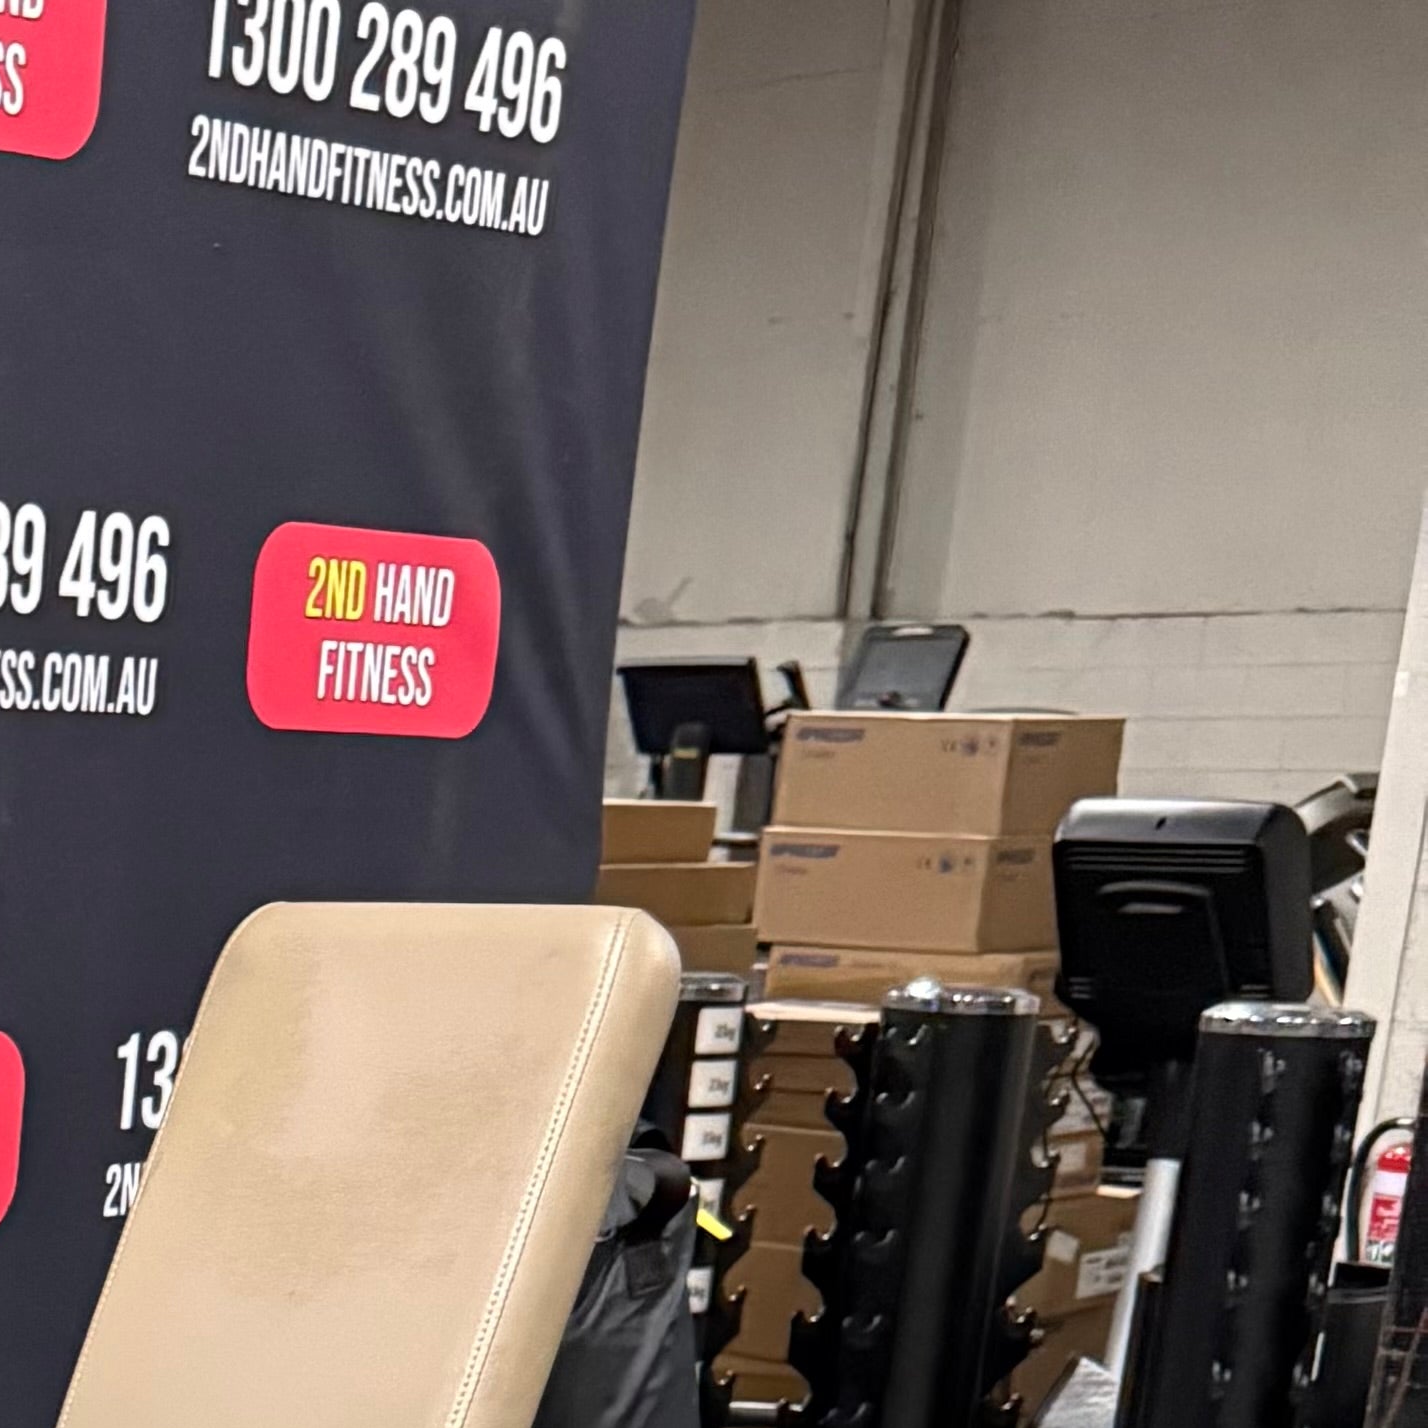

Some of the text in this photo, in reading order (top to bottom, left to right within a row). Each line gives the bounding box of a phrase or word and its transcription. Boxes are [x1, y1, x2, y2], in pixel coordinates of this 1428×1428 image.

[349, 2, 457, 125] 289
[464, 26, 567, 144] 496
[188, 114, 549, 237] 2NDHANDFITNESS.COM.AU
[57, 509, 171, 623] 496
[304, 556, 455, 629] 2ND HAND
[316, 639, 436, 709] FITNESS
[117, 1030, 190, 1130] 13
